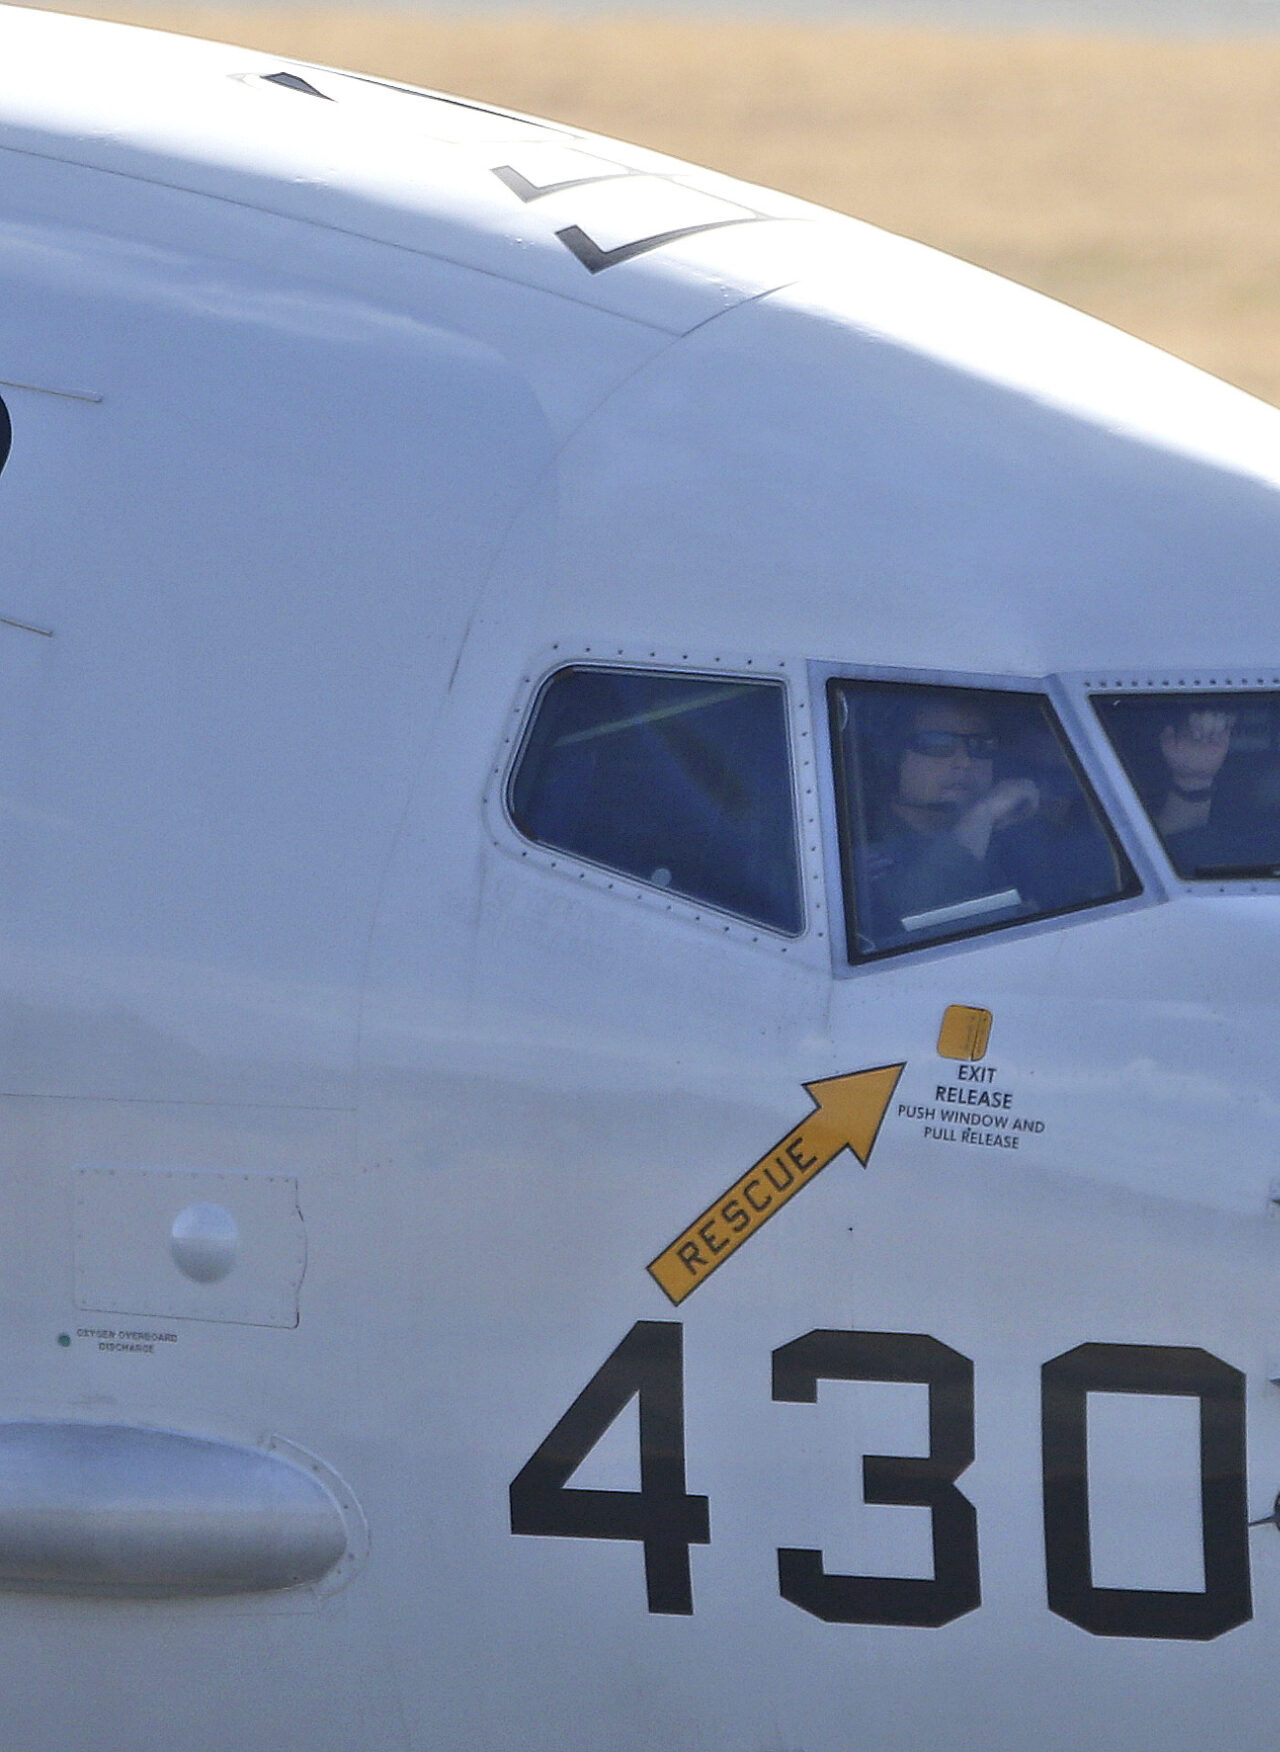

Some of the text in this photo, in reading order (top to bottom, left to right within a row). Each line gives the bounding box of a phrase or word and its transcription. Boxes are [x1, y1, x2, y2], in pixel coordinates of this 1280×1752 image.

[958, 1065, 997, 1083] EXIT
[935, 1086, 1013, 1109] RELEASE
[898, 1104, 1045, 1134] PUSH WINDOW AND
[924, 1126, 1020, 1149] PULL RELEASE
[676, 1137, 817, 1275] RESCUE
[509, 1320, 1253, 1641] 430
